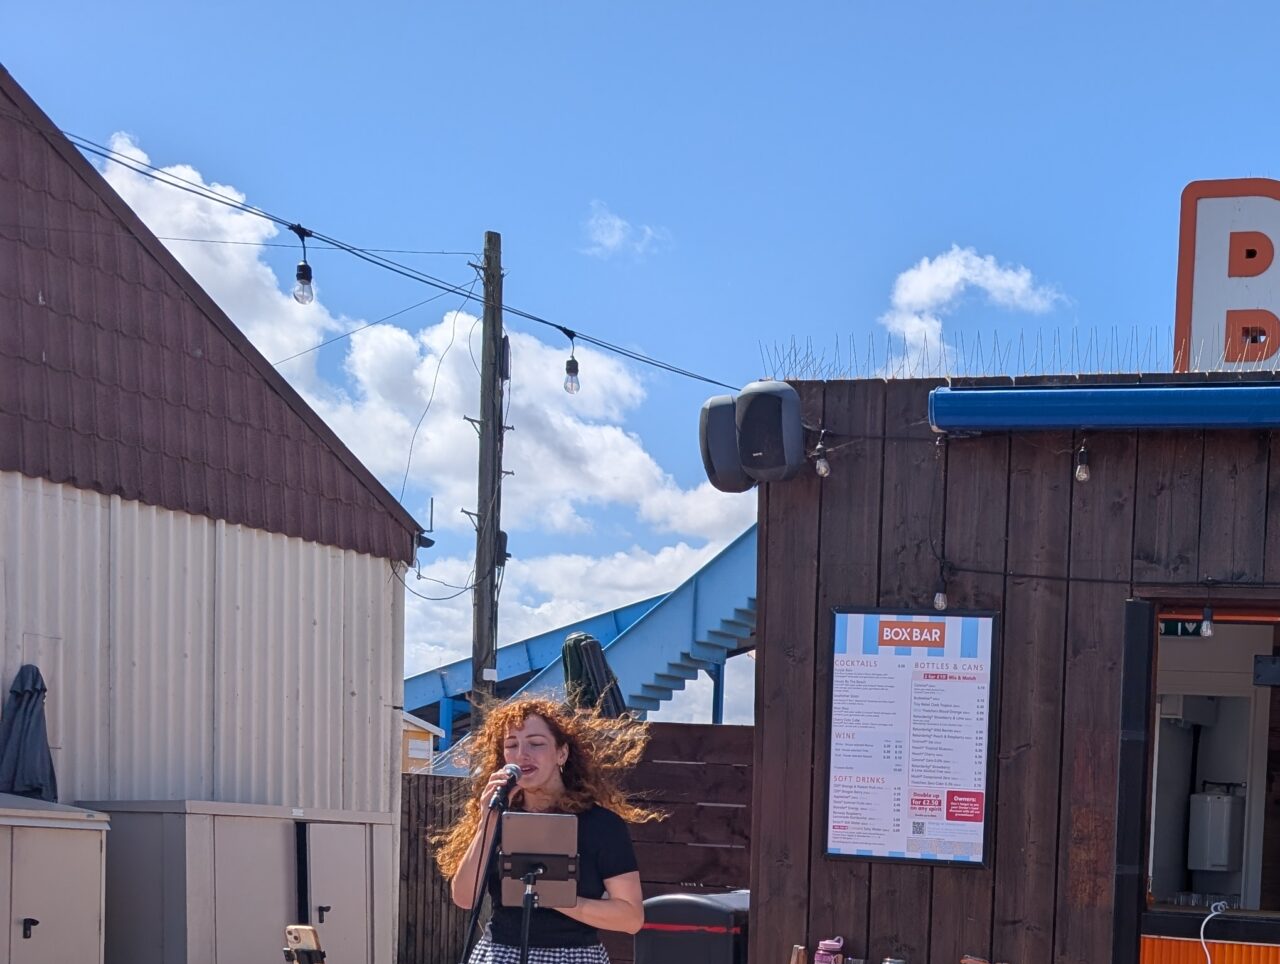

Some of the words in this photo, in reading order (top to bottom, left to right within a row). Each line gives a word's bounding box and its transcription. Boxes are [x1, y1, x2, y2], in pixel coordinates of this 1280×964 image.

[883, 627, 911, 641] BOX
[912, 628, 941, 642] BAR
[834, 659, 878, 667] COCKTAILS
[914, 662, 949, 670] BOTTLES
[855, 776, 886, 784] DRINKS
